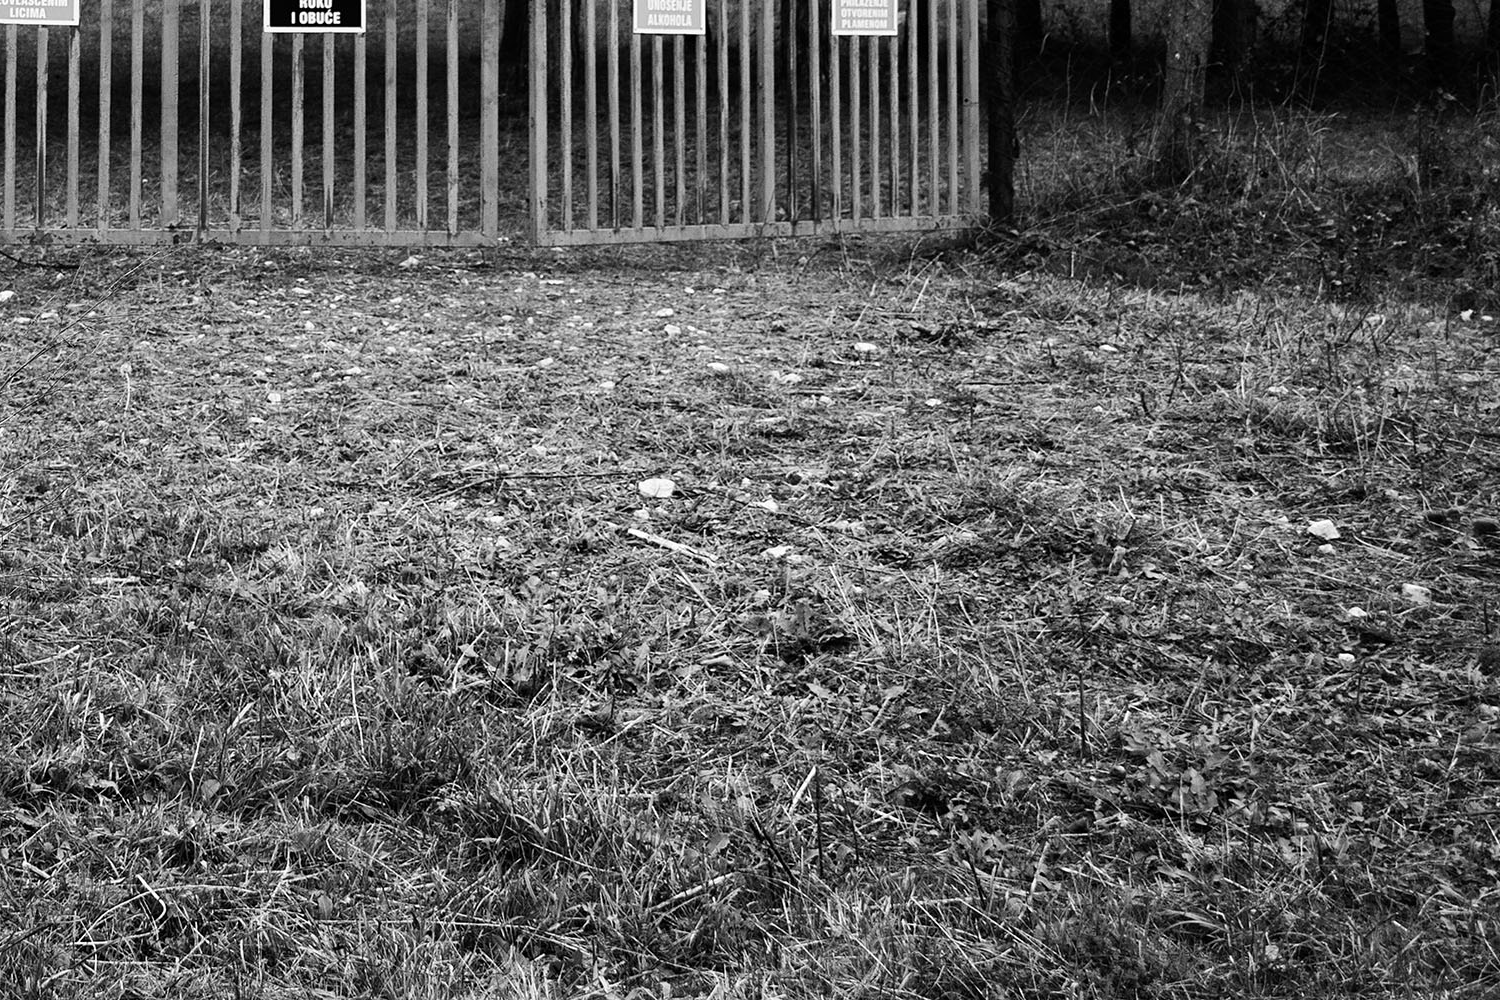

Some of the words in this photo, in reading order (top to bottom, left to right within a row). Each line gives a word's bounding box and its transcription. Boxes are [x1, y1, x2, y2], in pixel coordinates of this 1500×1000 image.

[9, 7, 46, 18] LICIMA
[291, 11, 296, 24] I
[299, 9, 341, 25] OBUĆE
[841, 8, 888, 18] OTVORENIM
[647, 14, 692, 26] ALKOHOLA
[841, 19, 888, 29] PLAMENOM
